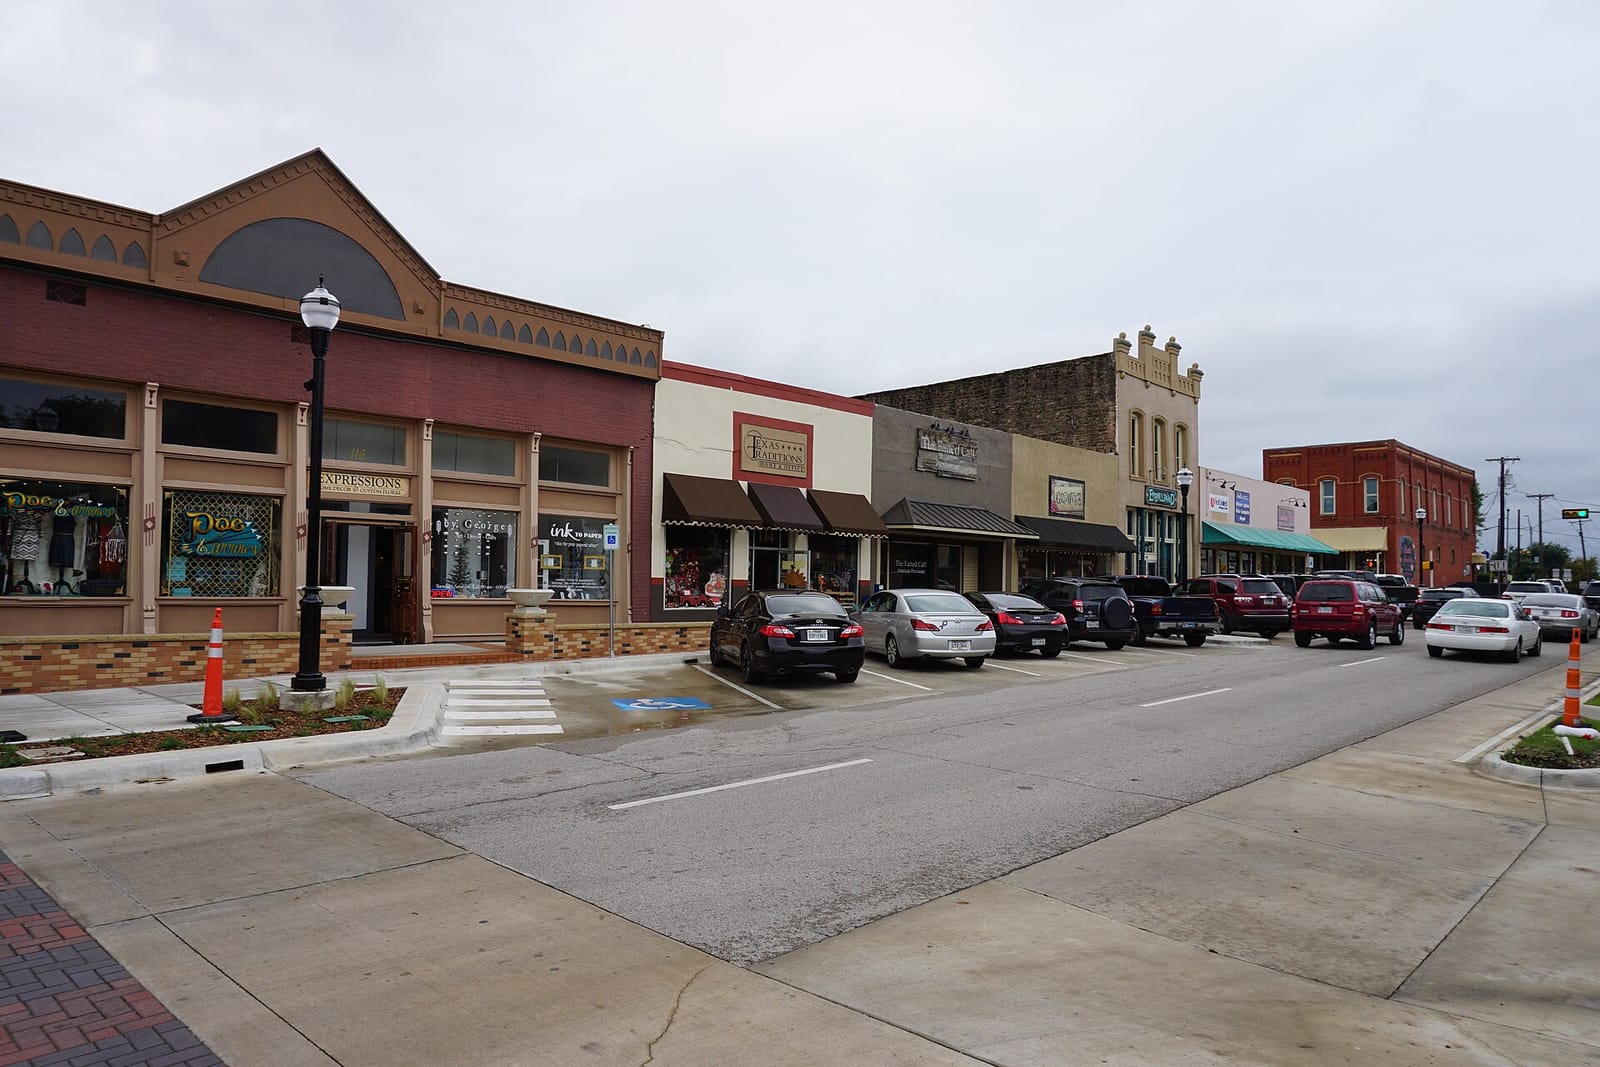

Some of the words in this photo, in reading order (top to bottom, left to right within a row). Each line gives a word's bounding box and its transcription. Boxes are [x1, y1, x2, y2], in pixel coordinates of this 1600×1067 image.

[747, 434, 780, 450] TEXAS
[747, 446, 803, 463] TRADITIONS
[443, 517, 457, 531] by
[464, 519, 506, 534] George
[550, 522, 581, 541] ink
